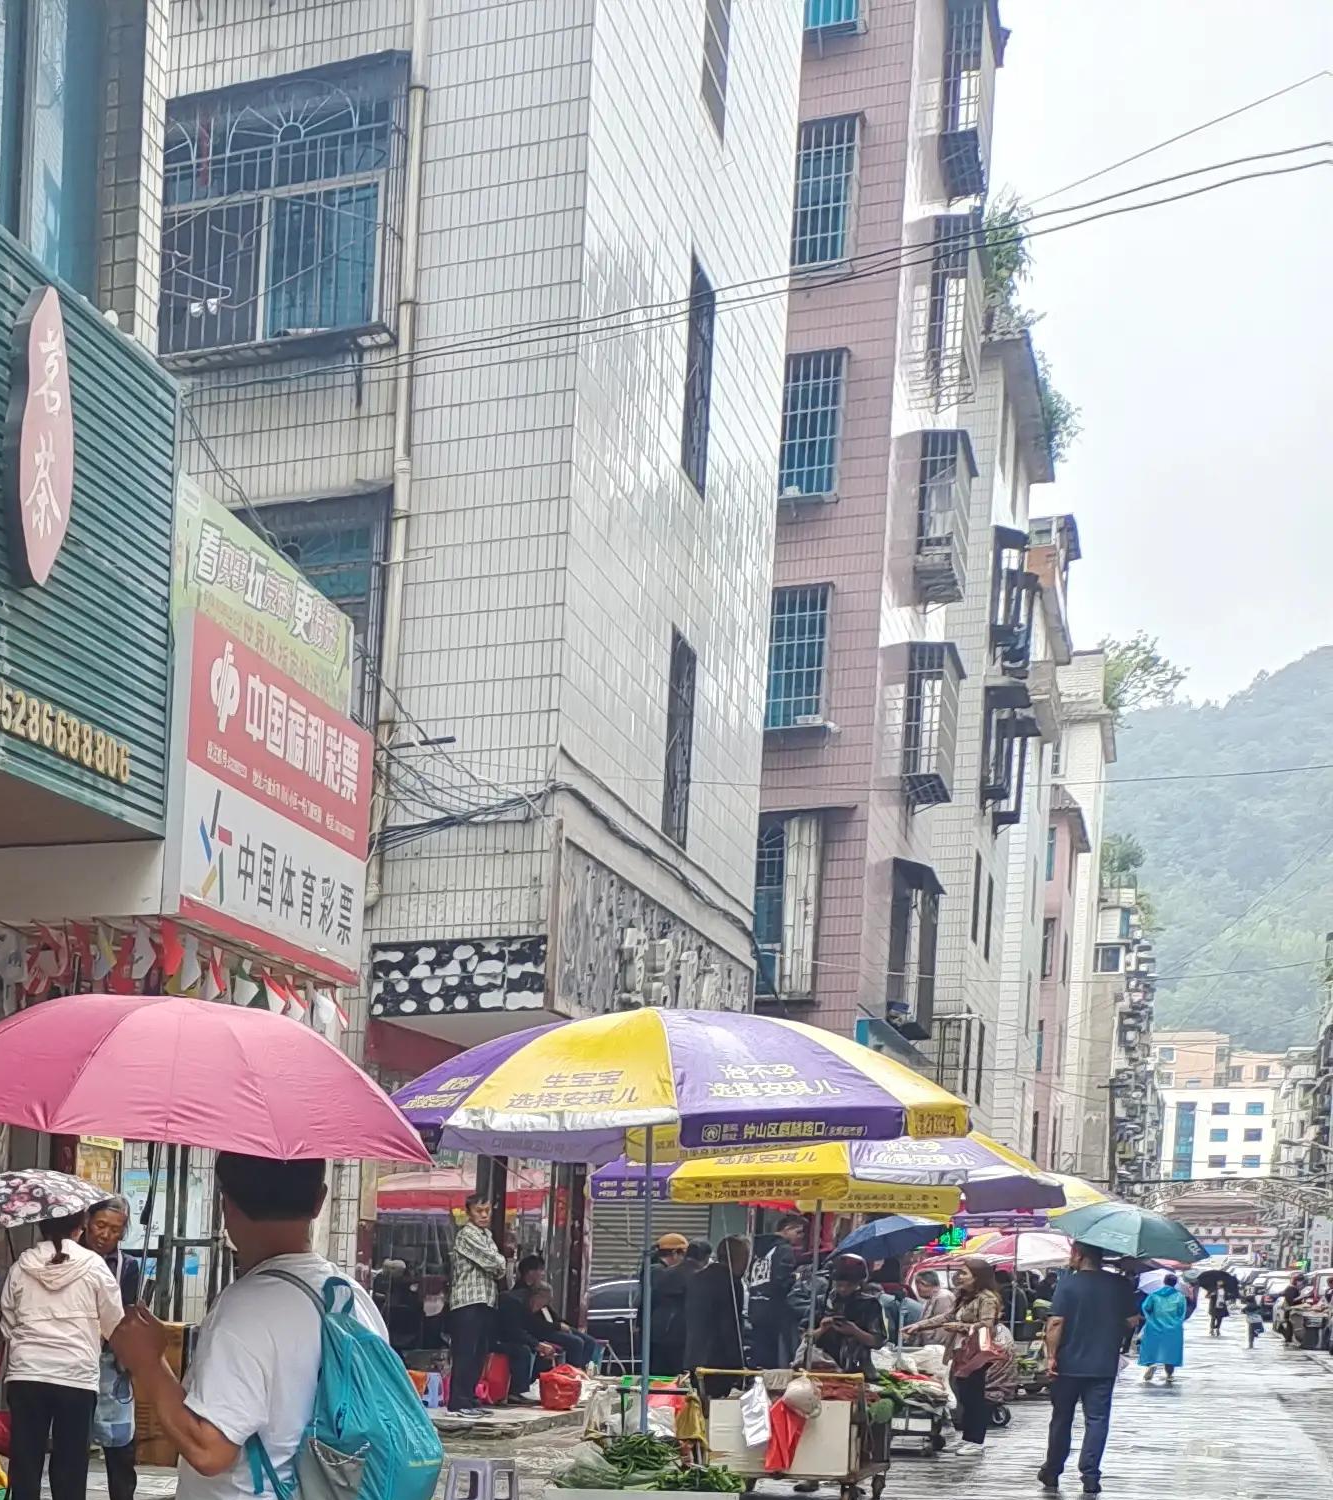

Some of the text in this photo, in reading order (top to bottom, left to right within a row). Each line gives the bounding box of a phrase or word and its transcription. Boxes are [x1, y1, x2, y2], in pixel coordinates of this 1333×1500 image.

[244, 671, 360, 806] 中国福利彩票
[237, 832, 354, 945] 中国体育彩票
[506, 1087, 638, 1109] 选择安琪儿
[544, 1070, 624, 1089] 生宝宝
